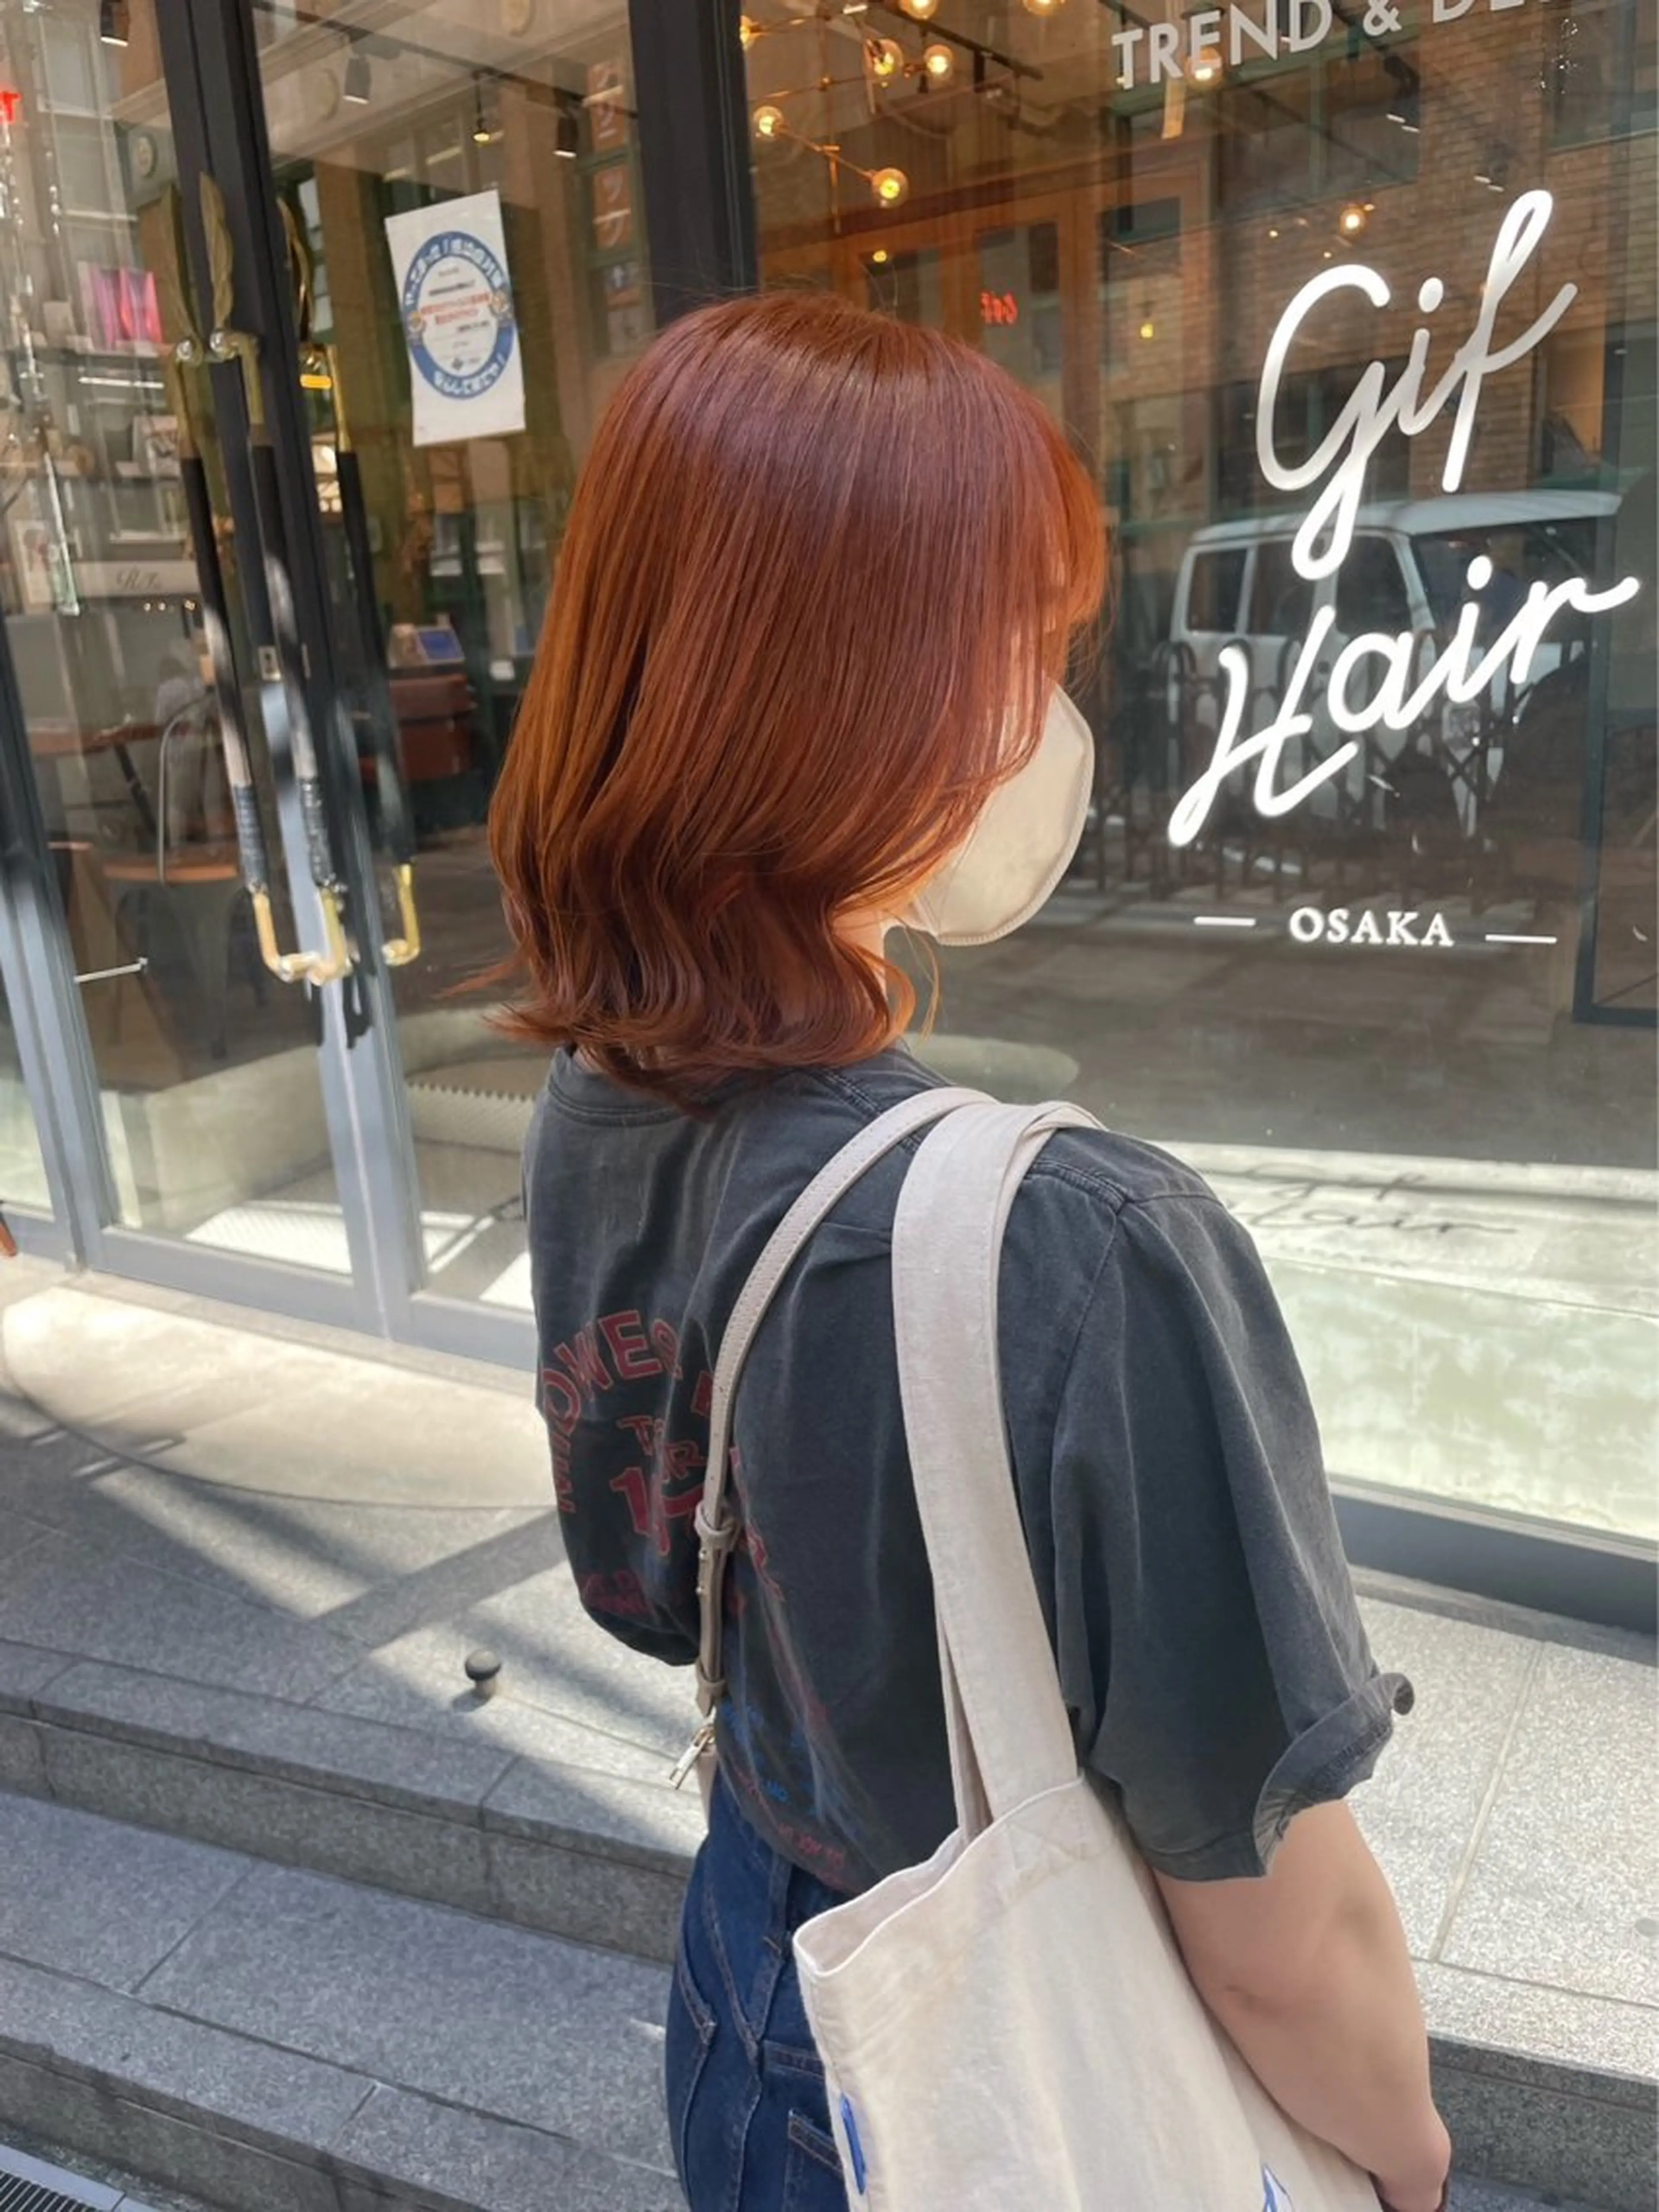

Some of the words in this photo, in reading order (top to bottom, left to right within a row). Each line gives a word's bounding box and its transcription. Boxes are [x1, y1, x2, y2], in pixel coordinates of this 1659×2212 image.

[1111, 0, 1332, 89] TREND
[1256, 190, 1577, 580] Gif
[1168, 555, 1639, 847] Hair
[1289, 907, 1454, 947] OSAKA
